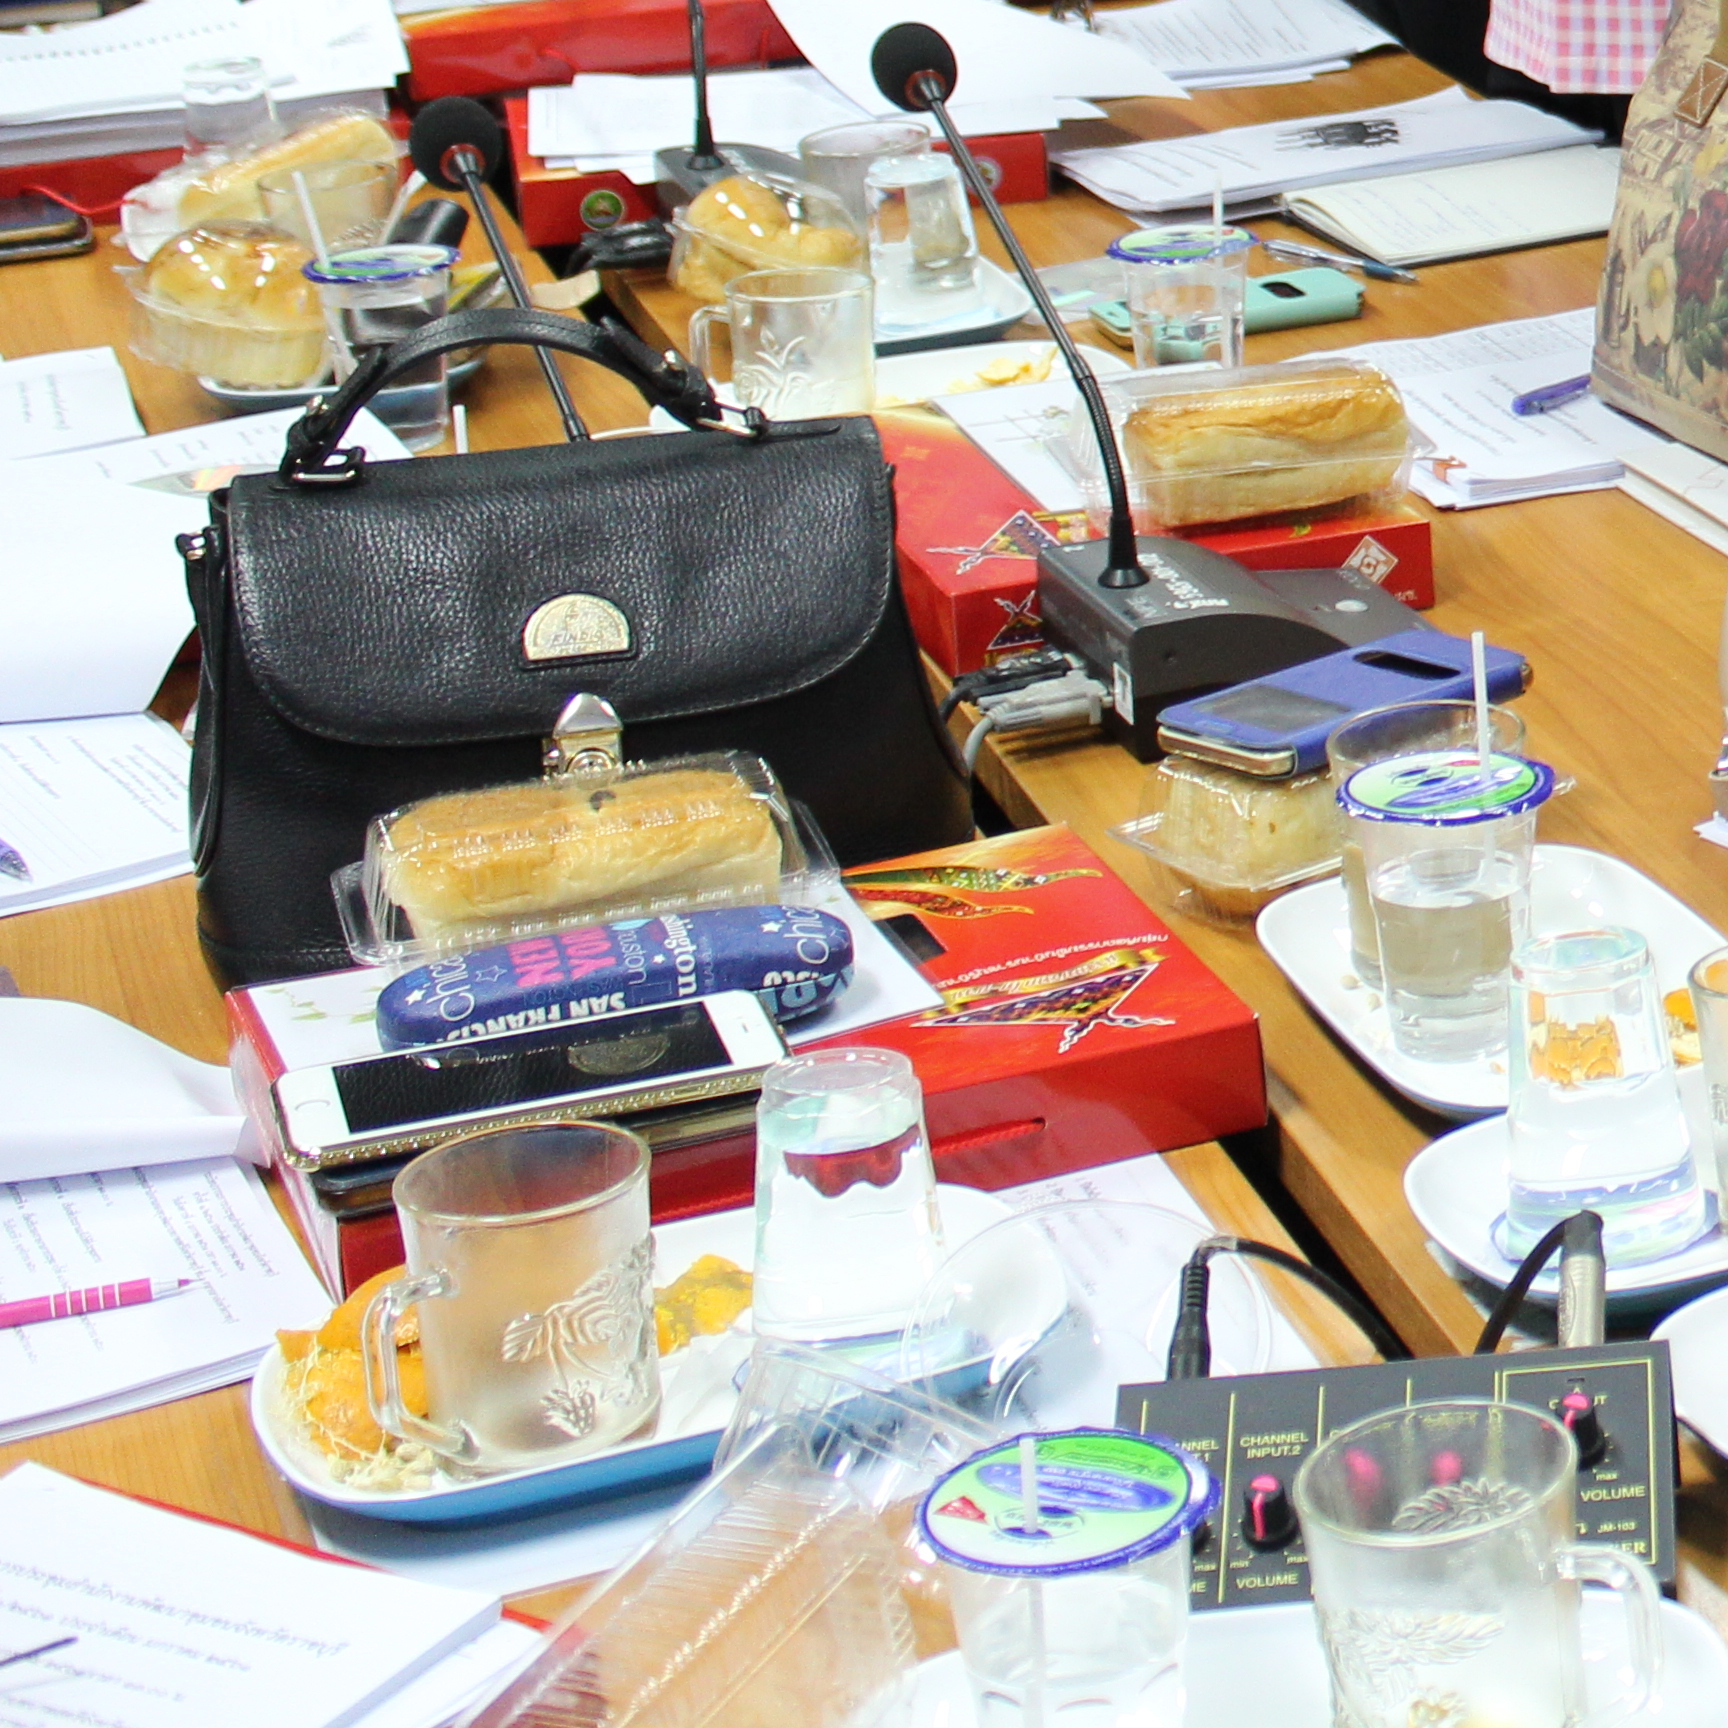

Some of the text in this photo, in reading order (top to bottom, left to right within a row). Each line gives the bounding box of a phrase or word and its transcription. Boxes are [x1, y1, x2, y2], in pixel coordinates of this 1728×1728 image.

[1240, 1432, 1309, 1448] CHANNEL
[1247, 1445, 1301, 1459] INPUT.2
[1596, 1472, 1619, 1481] max
[1580, 1485, 1646, 1502] VOLUME
[1194, 1562, 1217, 1571] max
[1230, 1560, 1250, 1569] min
[1236, 1573, 1298, 1589] VOLUME
